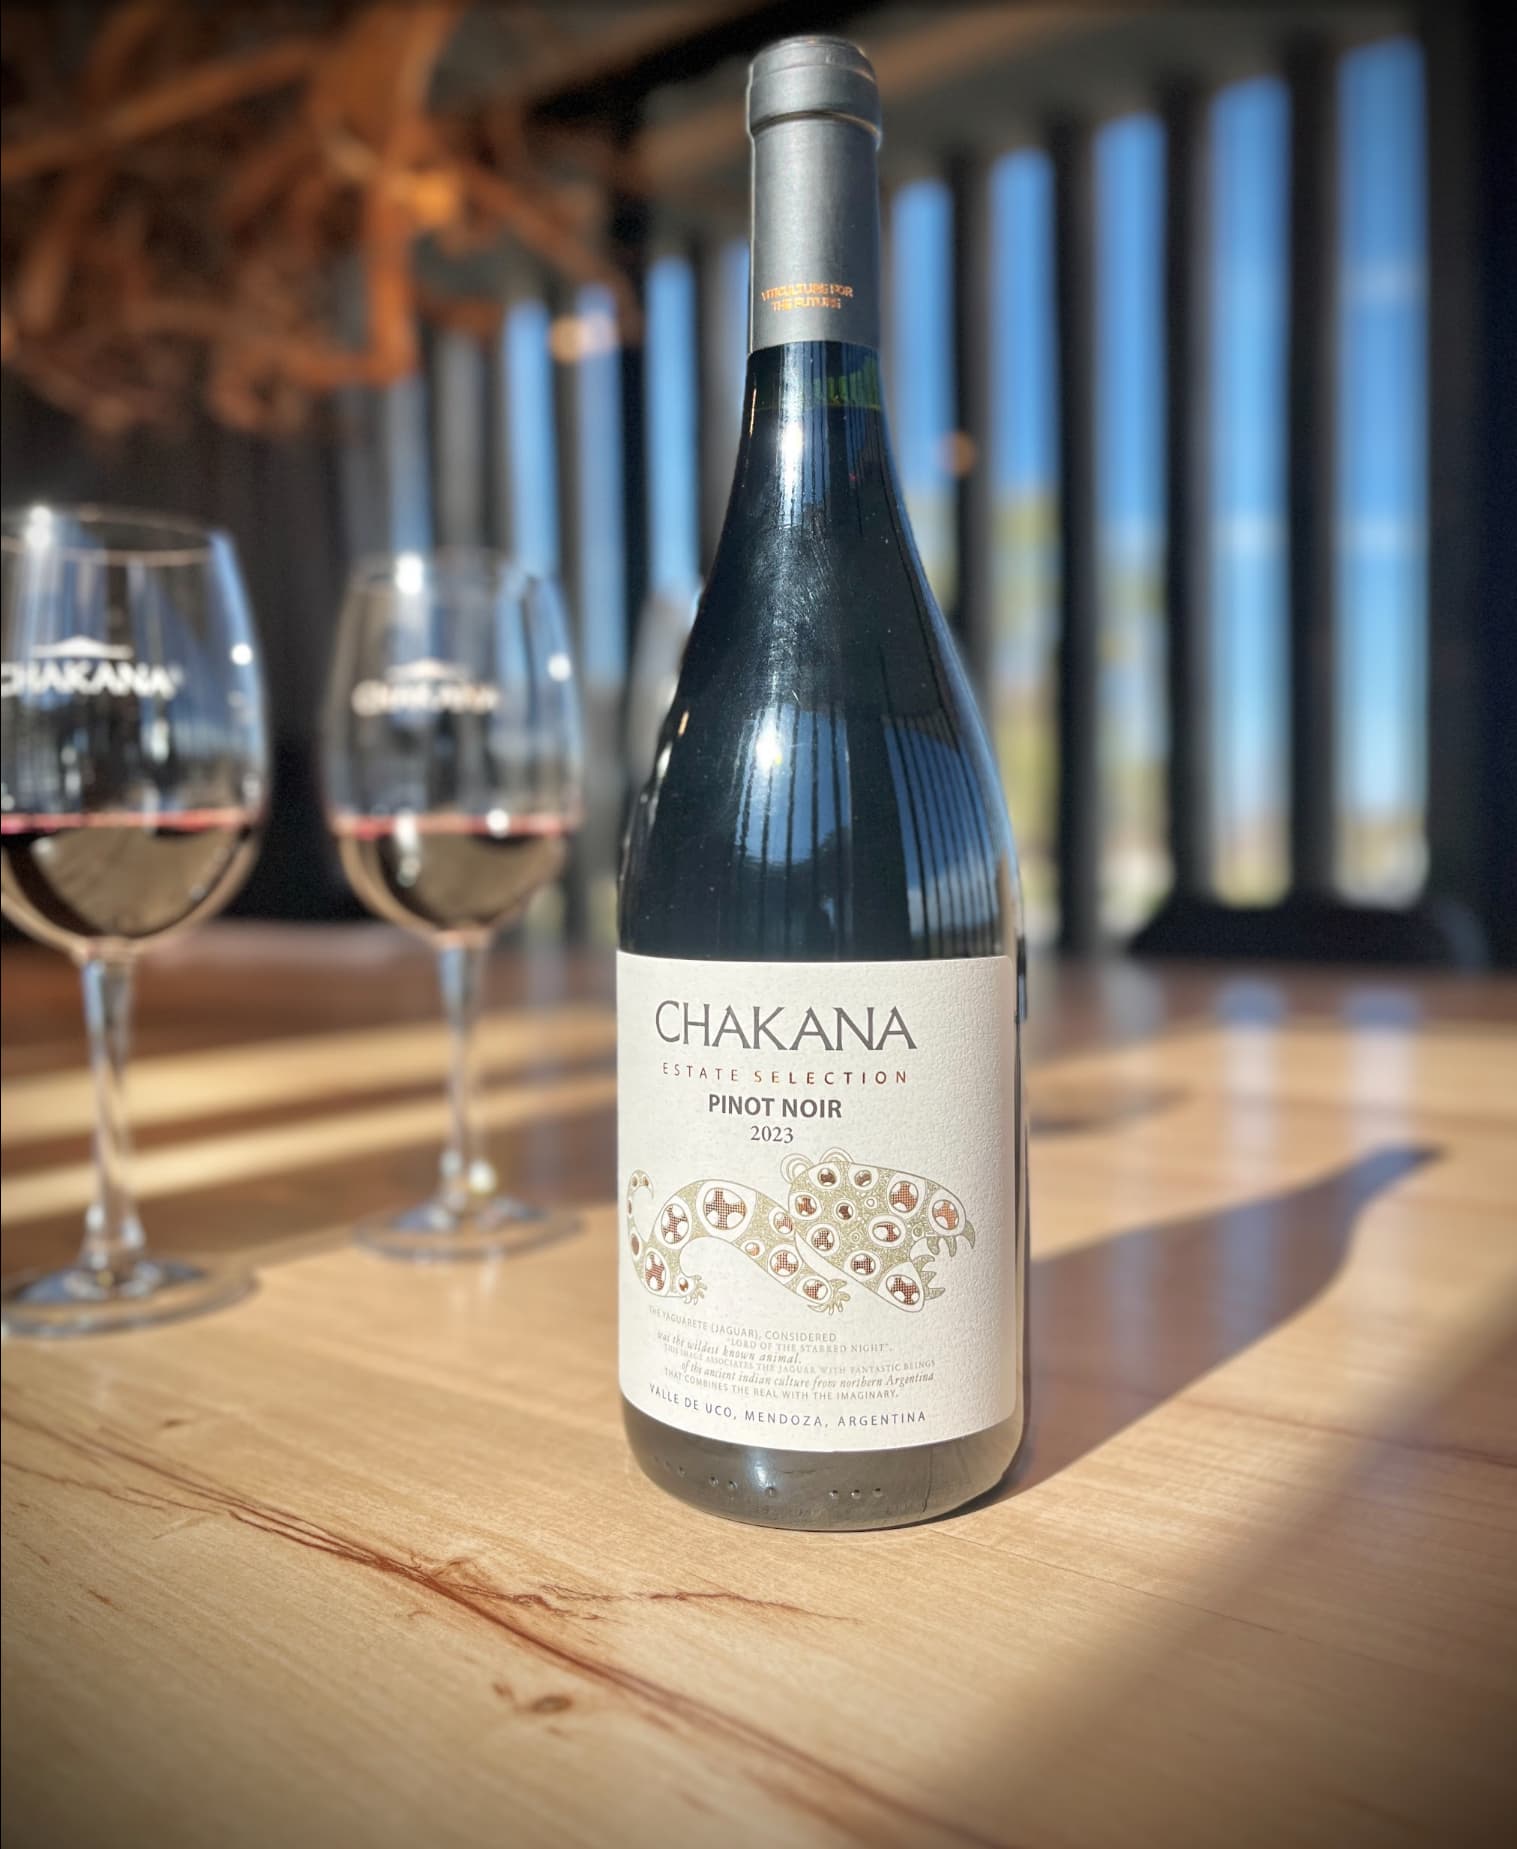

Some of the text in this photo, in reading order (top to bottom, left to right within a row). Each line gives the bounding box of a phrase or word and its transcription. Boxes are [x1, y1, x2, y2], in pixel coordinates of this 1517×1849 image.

[656, 1000, 917, 1051] CHAKANA
[663, 1062, 906, 1085] ESTATE SELECTION
[709, 1094, 842, 1119] PINOT NOIR
[750, 1125, 794, 1144] 2023
[649, 1305, 660, 1318] THE
[663, 1311, 708, 1330] YAGUARETE
[765, 1330, 837, 1343] CONSIDERED
[657, 1332, 802, 1364] was the wildest known animal.
[760, 1342, 772, 1351] OF
[777, 1343, 796, 1353] THE
[682, 1360, 934, 1390] of the ancient indian culture from northern Argentina
[706, 1355, 754, 1369] ASSOCIATES
[756, 1362, 775, 1372] THE
[777, 1364, 816, 1374] JAGUAR
[819, 1366, 846, 1374] WITH
[851, 1363, 901, 1374] FANTASTIC
[904, 1359, 936, 1371] BEINGS
[665, 1367, 899, 1401] THAT COMBINES THE REAL WITH THE IMAGINARY.
[649, 1384, 926, 1428] VALLE DE UCO, MENDOZA, ARGENTINA
